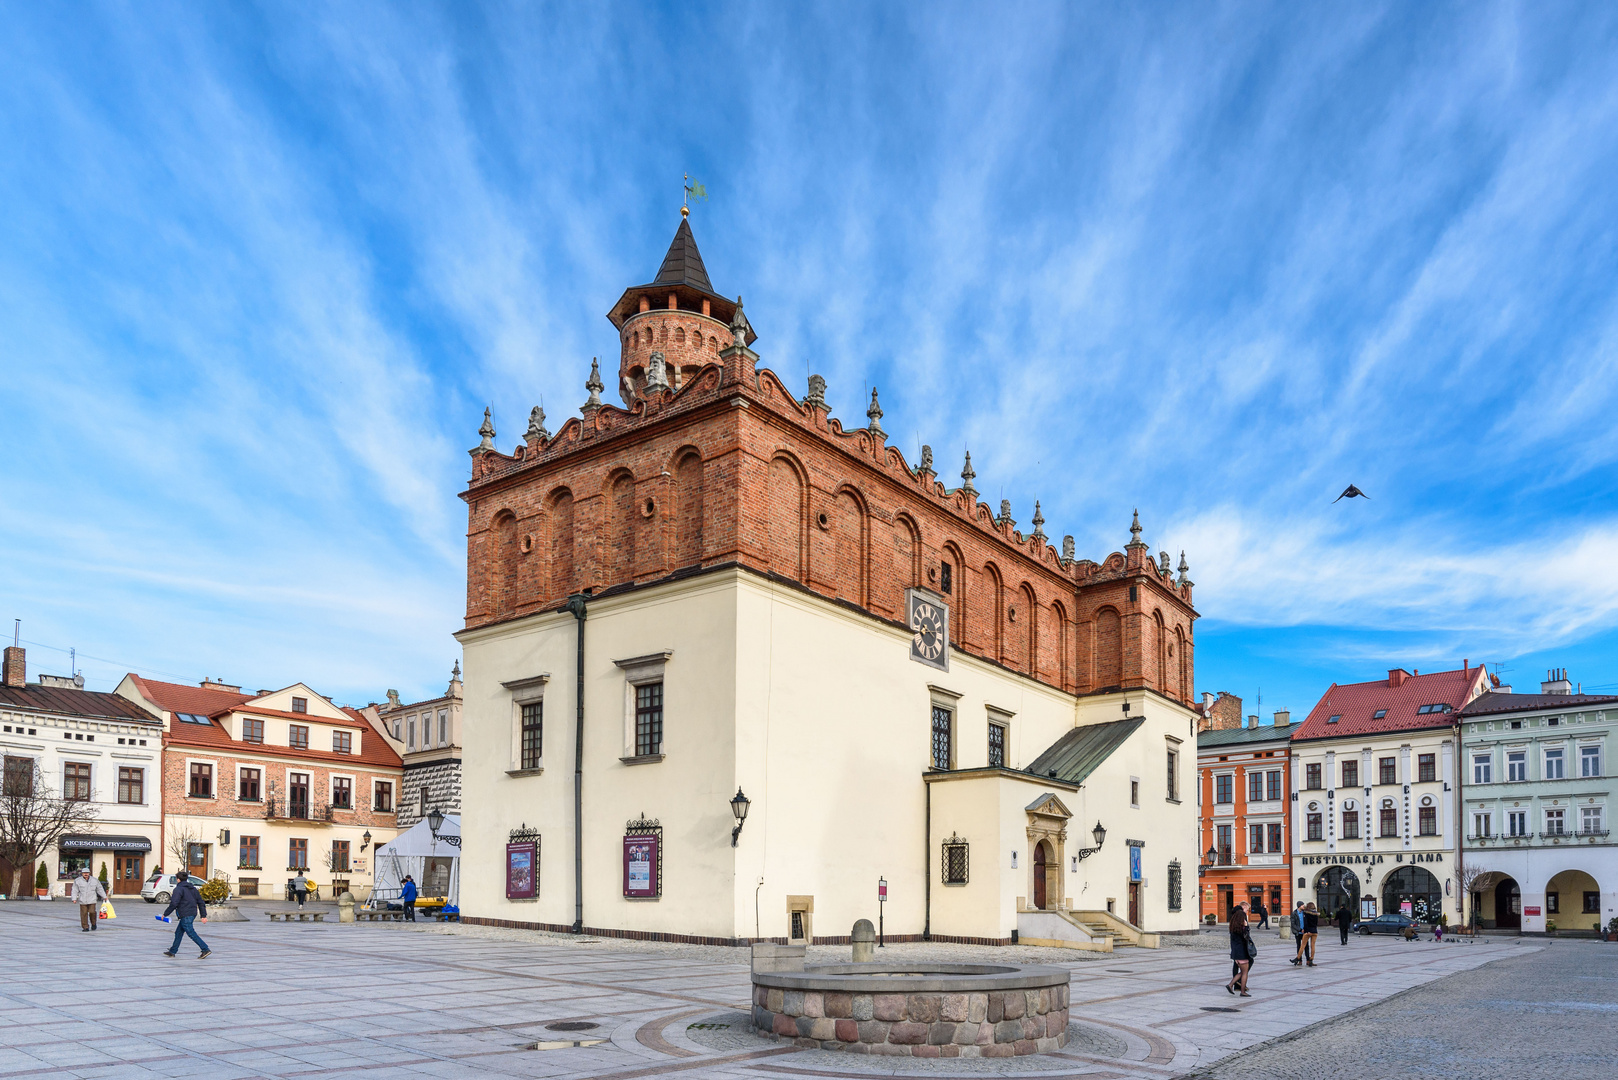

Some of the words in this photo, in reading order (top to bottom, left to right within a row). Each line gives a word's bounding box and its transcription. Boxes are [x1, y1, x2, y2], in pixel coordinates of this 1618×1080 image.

[1292, 782, 1451, 801] HOTEL
[1302, 854, 1384, 866] RESTAURACJA
[1396, 853, 1404, 863] U
[1410, 852, 1443, 866] JANA
